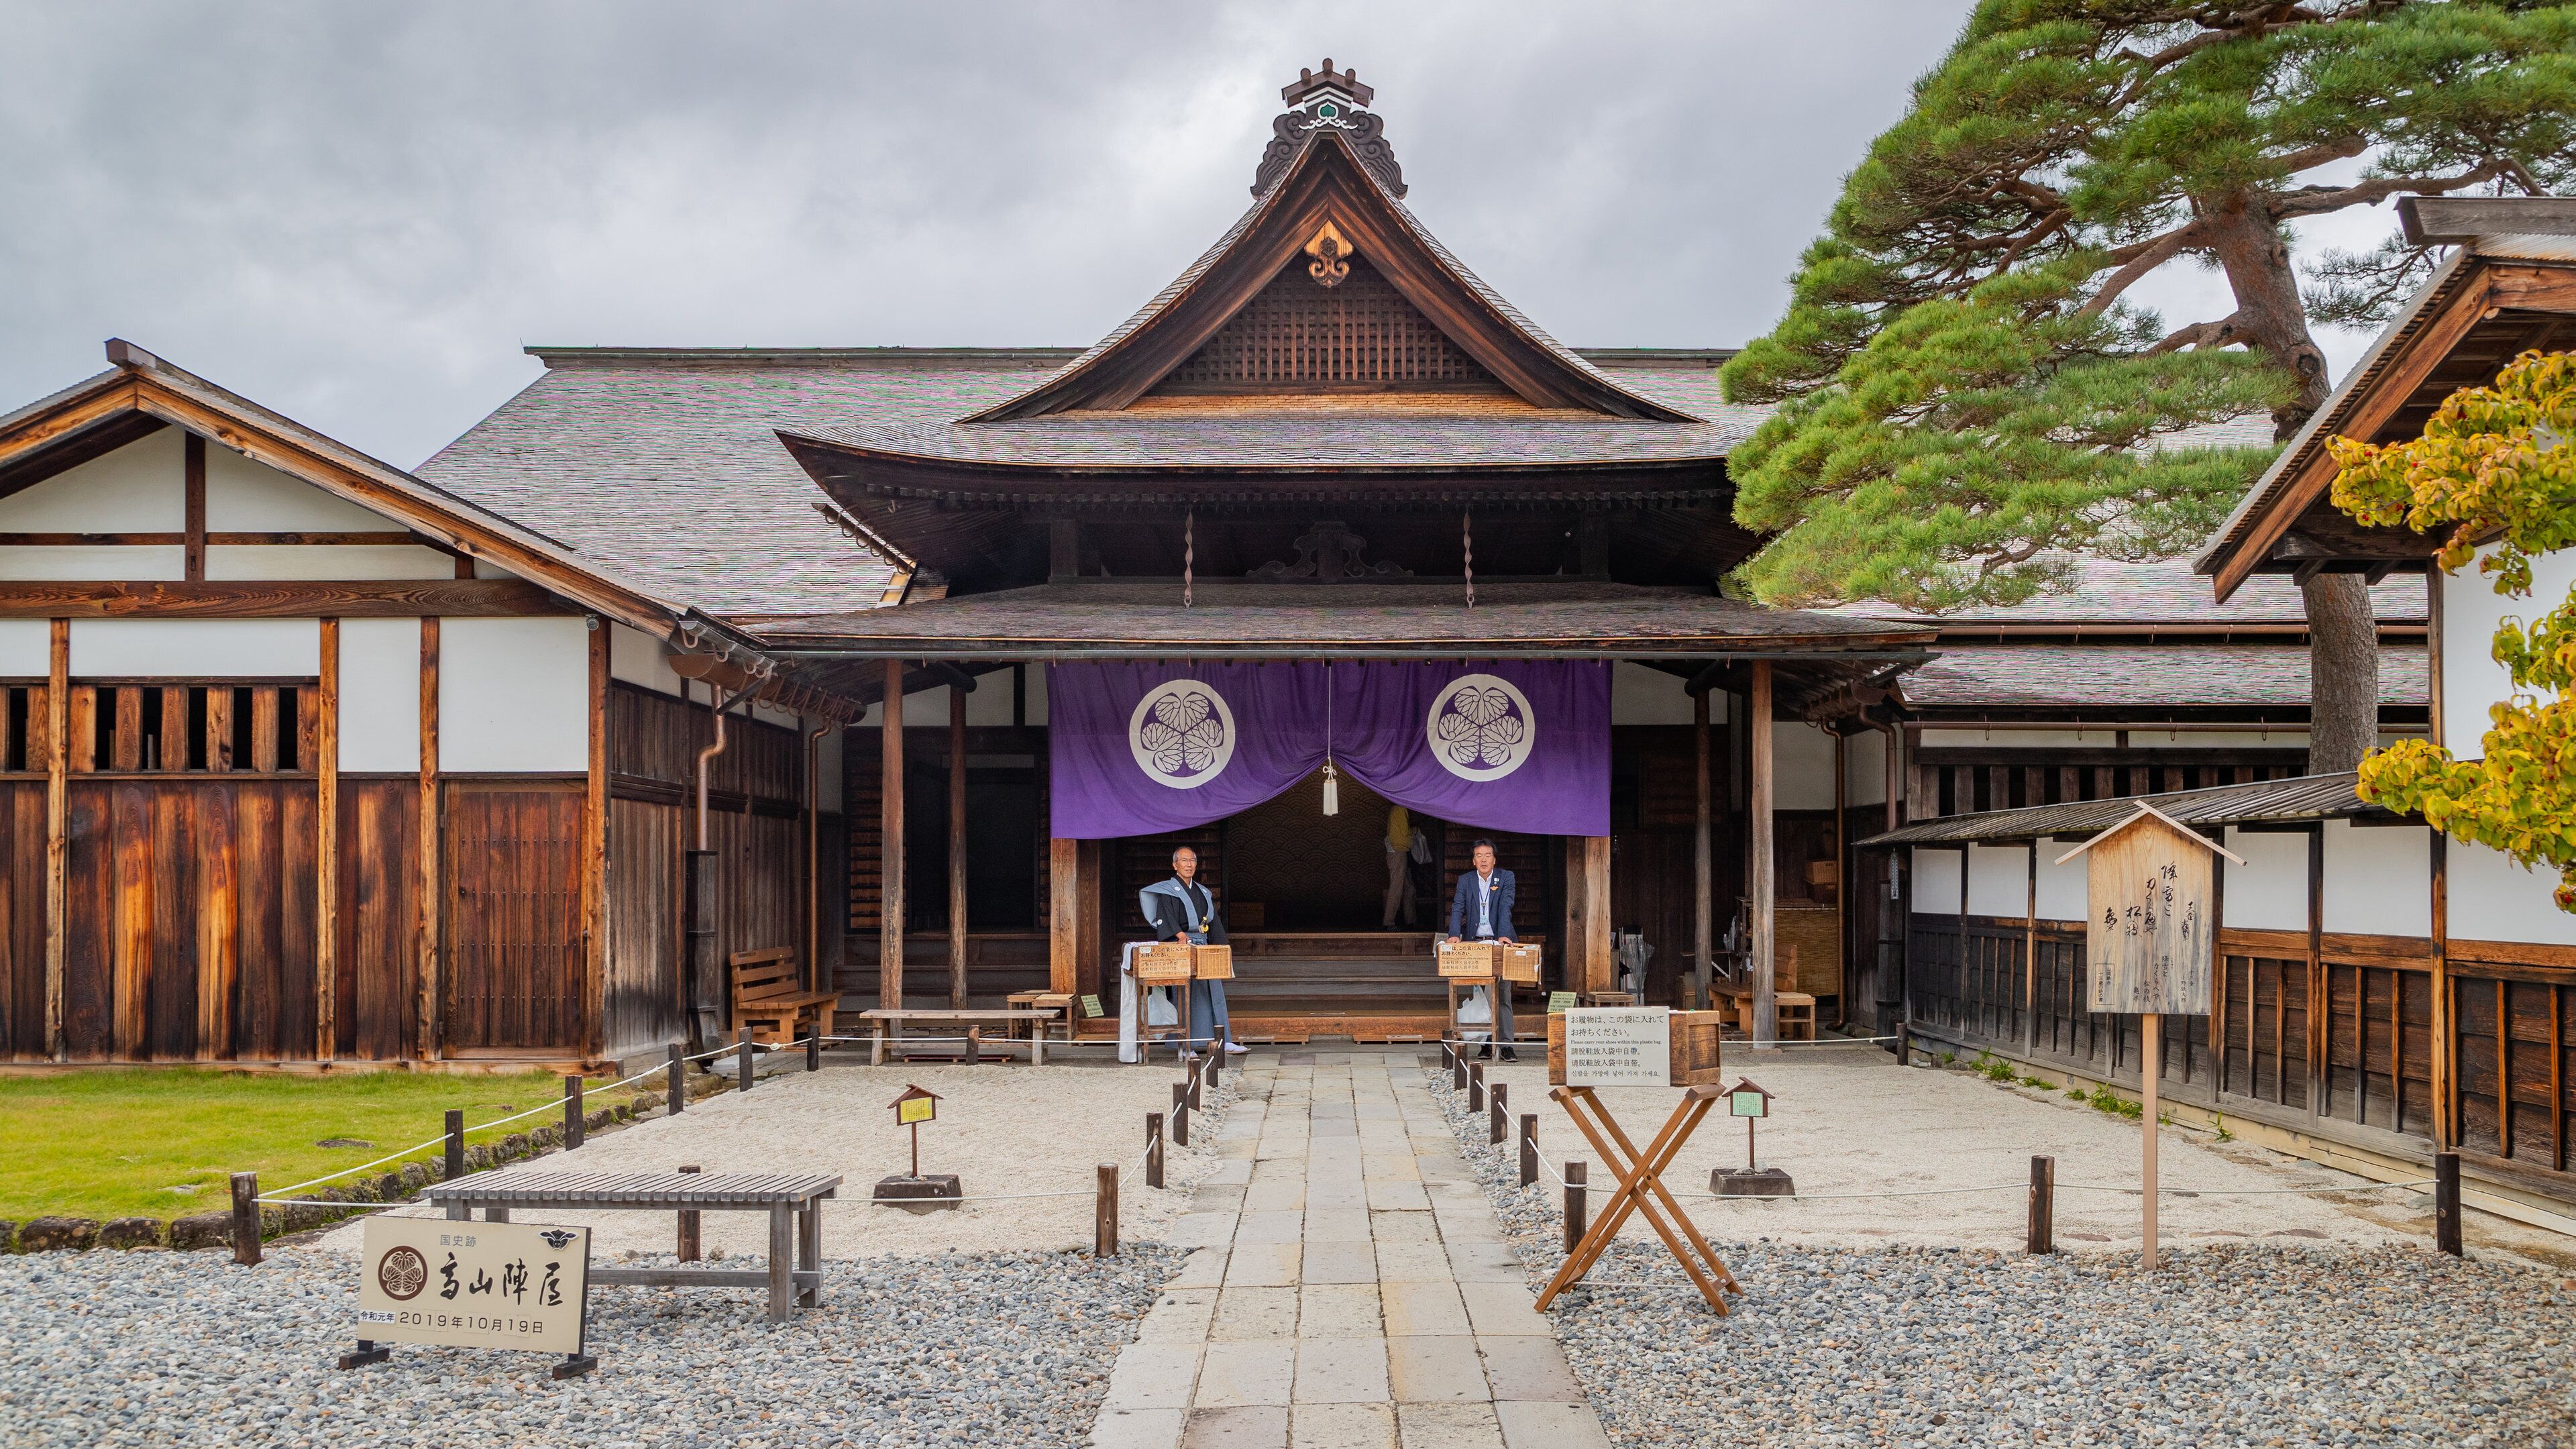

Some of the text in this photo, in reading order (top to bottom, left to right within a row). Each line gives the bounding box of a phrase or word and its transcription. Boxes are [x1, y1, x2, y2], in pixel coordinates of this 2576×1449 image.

[1570, 1015, 1664, 1024] お履物は、この袋に入れて
[1570, 1028, 1630, 1037] お持ちください。
[440, 1234, 477, 1248] 国史跡
[439, 1251, 564, 1306] 高山陣屋
[360, 1311, 394, 1322] 令和元年
